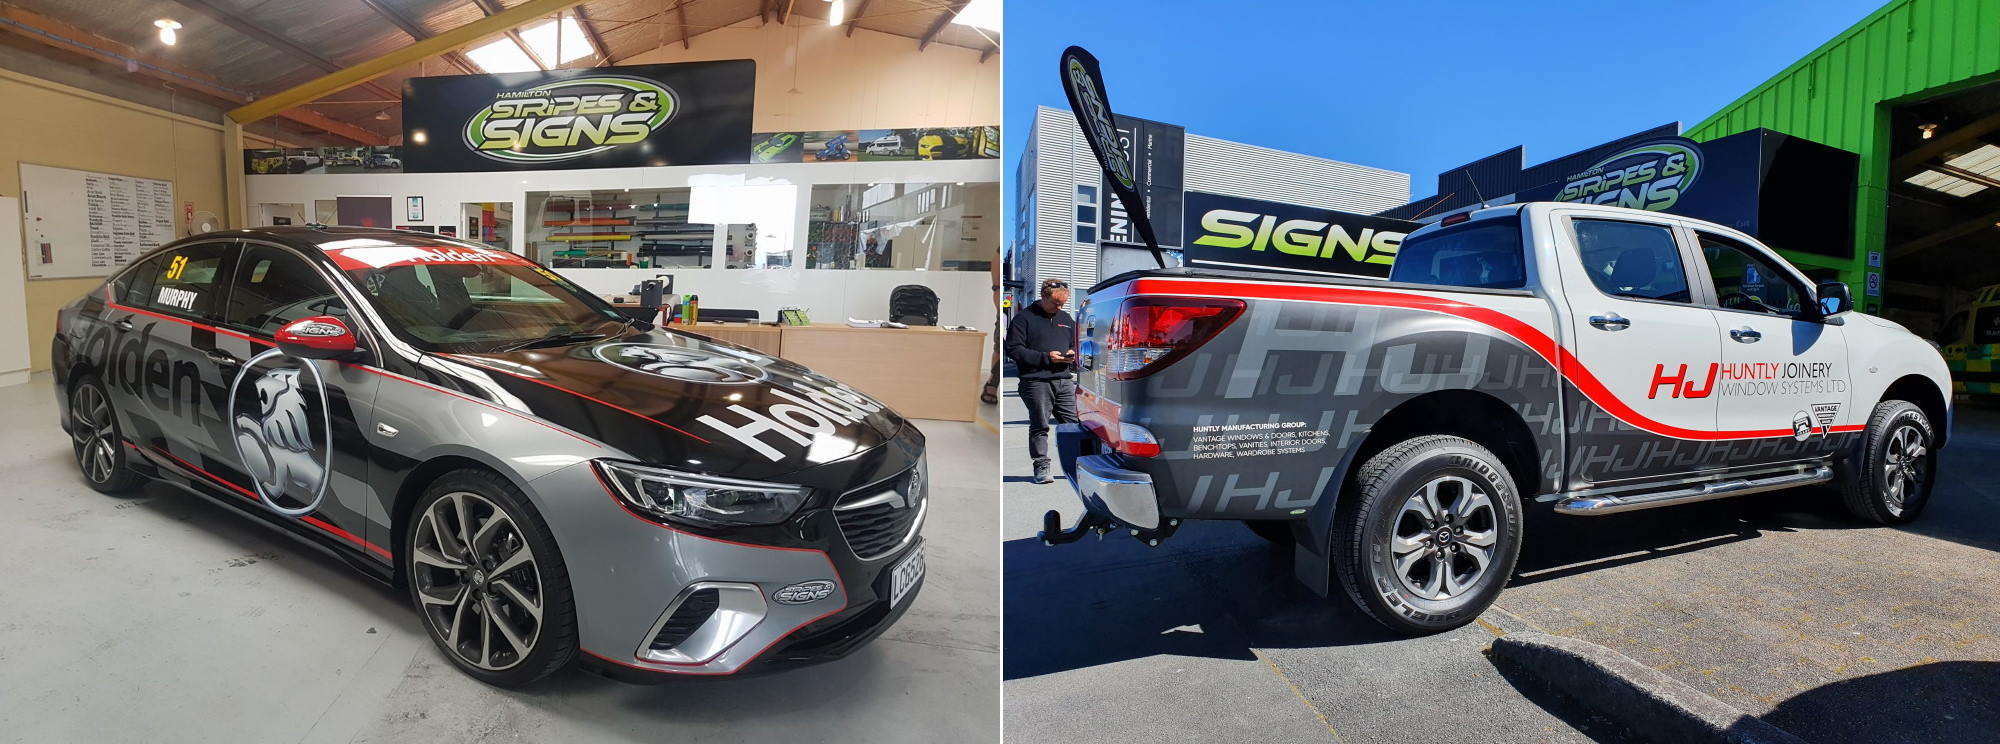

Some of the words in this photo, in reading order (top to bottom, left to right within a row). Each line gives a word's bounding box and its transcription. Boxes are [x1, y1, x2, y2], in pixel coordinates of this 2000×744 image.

[496, 90, 552, 99] HAMILTON
[629, 92, 662, 111] &
[477, 112, 657, 150] SIGNS
[1661, 152, 1688, 177] &
[1566, 167, 1604, 182] HAMILTON
[1570, 175, 1684, 212] GNS
[1193, 209, 1408, 266] SIGNS
[167, 255, 189, 280] 51
[157, 286, 198, 310] MURPHY
[1647, 363, 1719, 399] HJ
[1721, 363, 1779, 380] HUNTLY
[1782, 362, 1832, 379] JOINERY
[1720, 381, 1779, 397] WINDOW
[1781, 380, 1824, 396] SYSTEMS
[1826, 379, 1847, 393] LTD
[1221, 423, 1280, 431] MANUFACTURING
[1193, 435, 1226, 443] VANTAGE
[1271, 439, 1300, 447] INTERIOR
[1237, 449, 1276, 457] WARDROBE
[1447, 455, 1517, 543] BRIDGESTON
[780, 589, 829, 601] SIGNS
